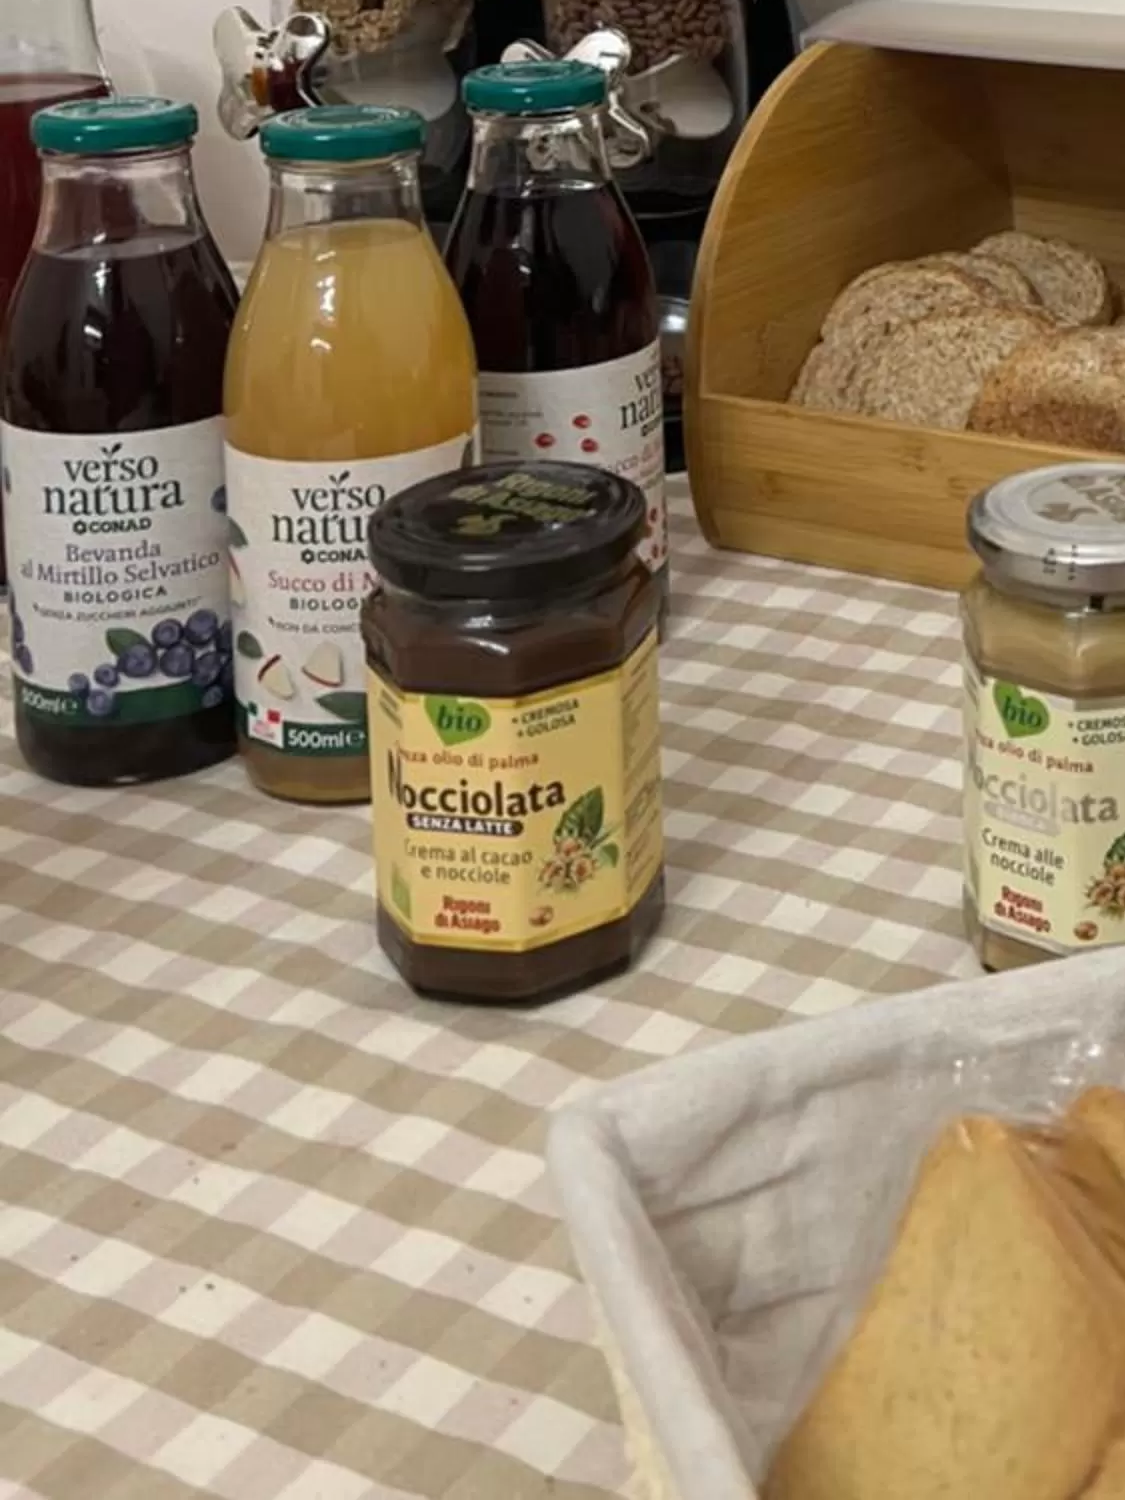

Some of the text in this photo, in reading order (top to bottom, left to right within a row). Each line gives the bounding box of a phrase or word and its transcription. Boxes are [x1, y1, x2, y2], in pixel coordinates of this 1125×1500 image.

[64, 450, 159, 485] verso
[44, 481, 184, 517] natura
[292, 480, 386, 513] verso
[90, 518, 151, 535] CONAD
[272, 512, 368, 545] natu
[65, 541, 162, 562] Bevanda
[317, 549, 369, 564] CONA
[37, 564, 119, 586] Mirtillo
[124, 552, 220, 584] Selvatico
[267, 570, 327, 594] Succo
[332, 570, 355, 592] di
[64, 585, 167, 605] BIOLOGICA
[289, 597, 359, 611] BIOLOG
[437, 705, 482, 732] bio
[521, 699, 579, 725] CREMOSA
[1003, 696, 1042, 728] bio
[287, 729, 344, 749] 500ml
[526, 714, 576, 738] GOLOSA
[432, 749, 464, 766] olio
[468, 753, 483, 768] di
[489, 752, 539, 772] palma
[998, 740, 1024, 760] olio
[1027, 747, 1042, 764] di
[1046, 755, 1094, 773] palma
[388, 748, 565, 817] Nocciolata
[973, 763, 1119, 824] occiolata
[411, 815, 513, 835] SENZA LATTE
[404, 838, 532, 865] Crema al cacao
[981, 827, 1065, 870] Crema alle
[421, 864, 511, 885] e nocciole
[990, 851, 1056, 887] nocciole
